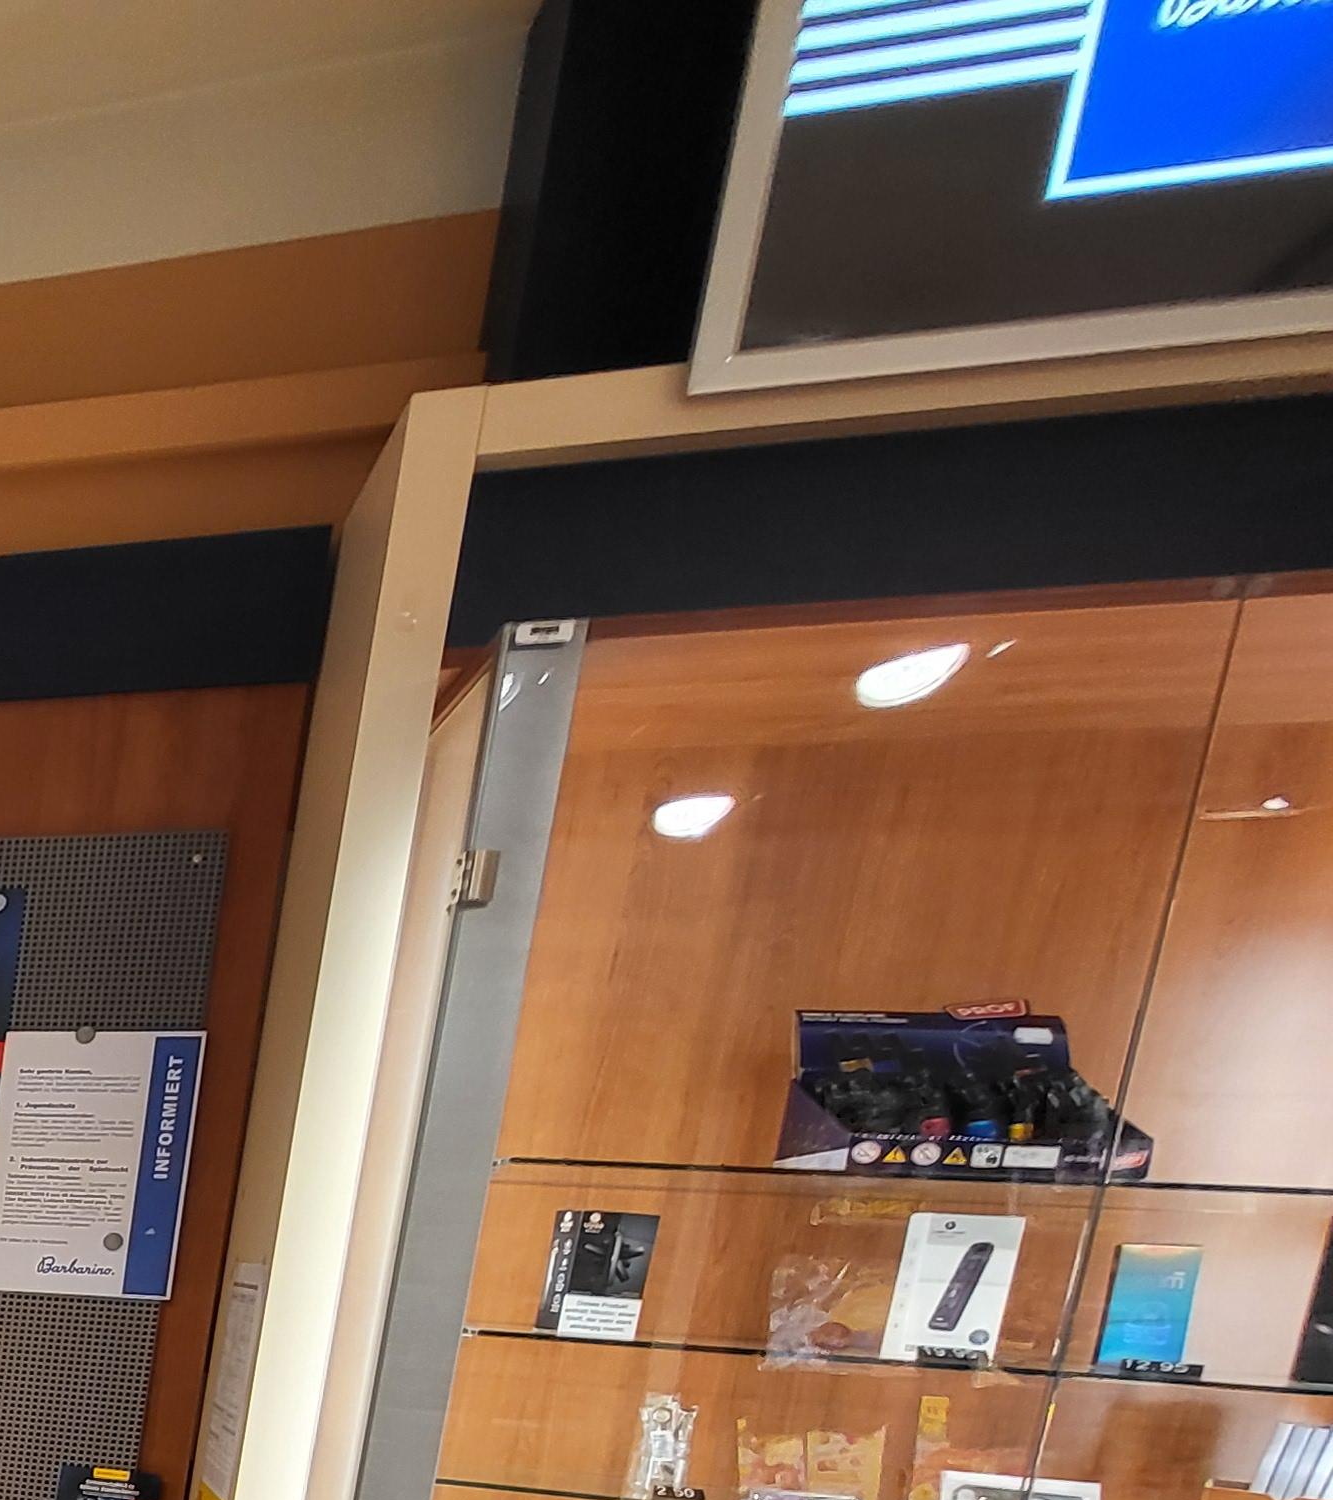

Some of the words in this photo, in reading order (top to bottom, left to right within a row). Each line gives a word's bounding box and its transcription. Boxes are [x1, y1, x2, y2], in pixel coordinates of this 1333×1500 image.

[957, 1002, 1017, 1017] PROF
[153, 1055, 183, 1180] INFORMIERT
[1123, 1359, 1189, 1373] 12.95
